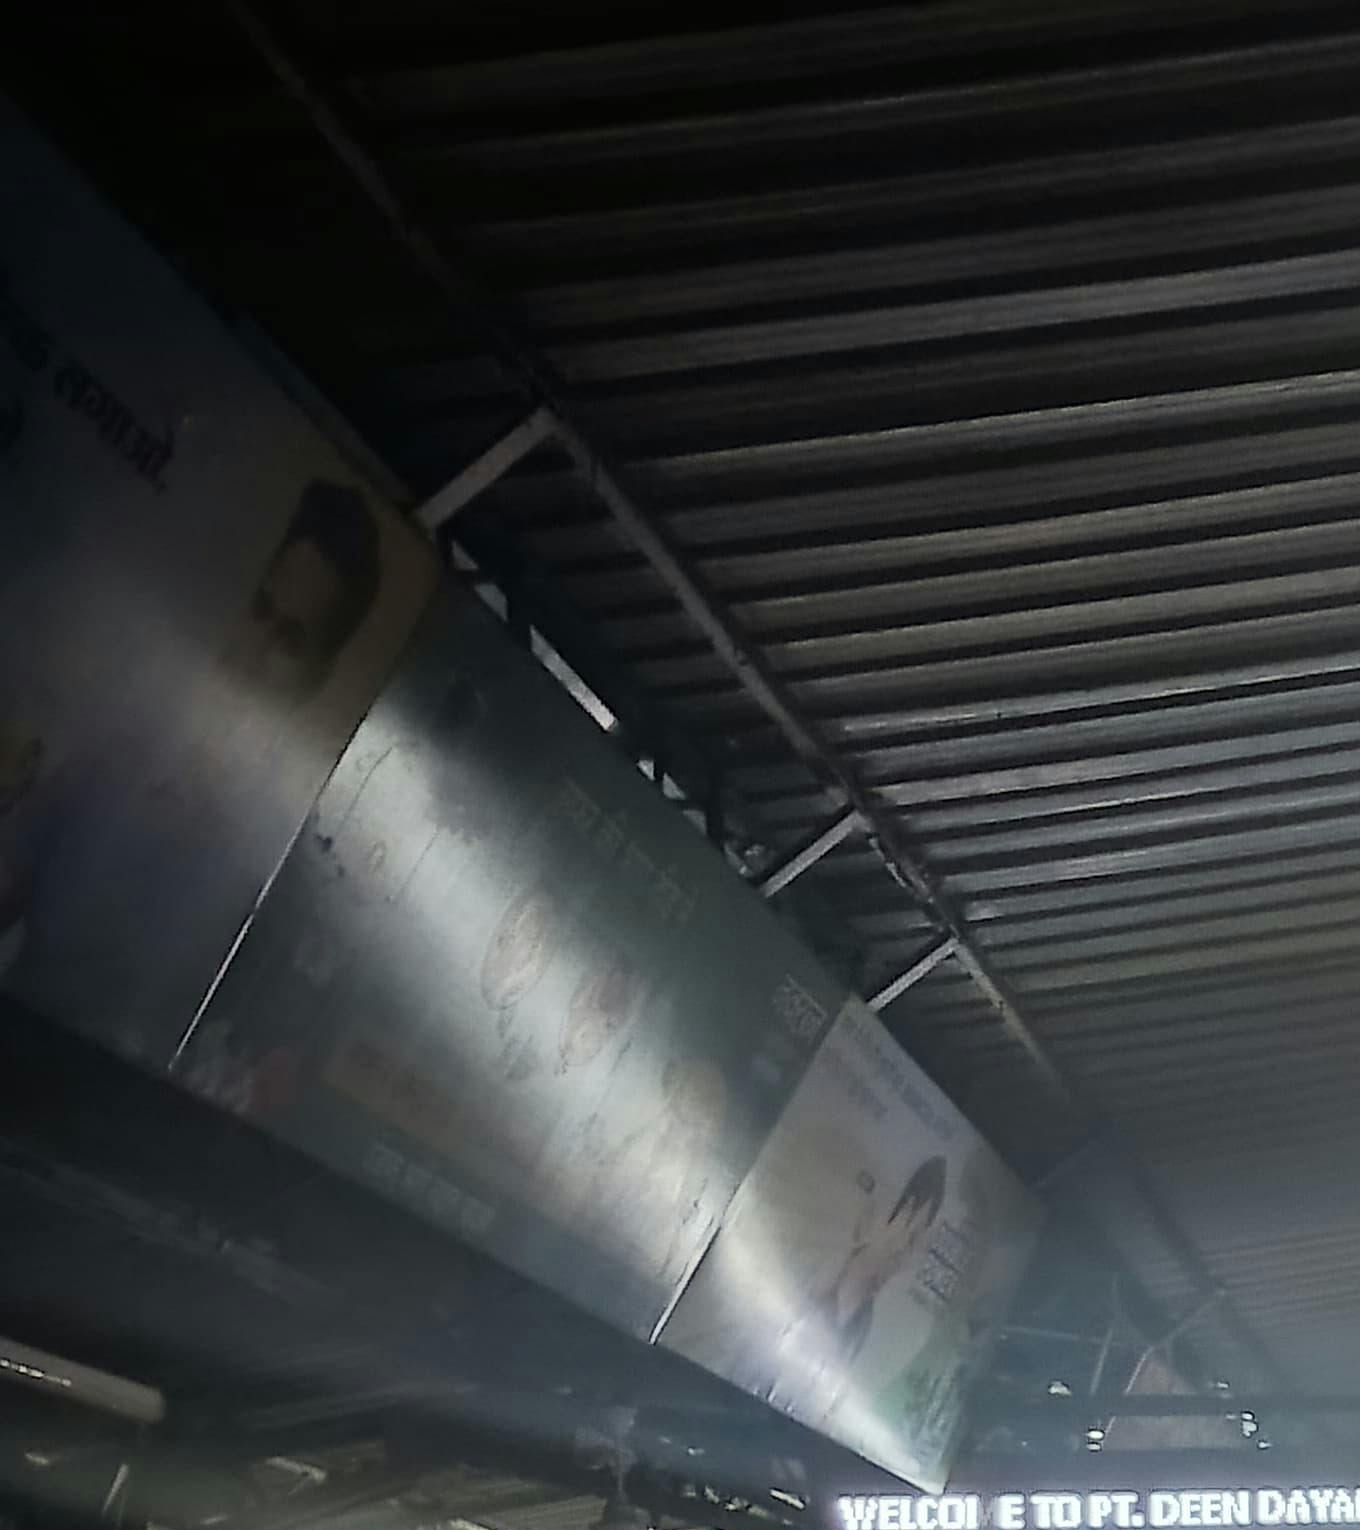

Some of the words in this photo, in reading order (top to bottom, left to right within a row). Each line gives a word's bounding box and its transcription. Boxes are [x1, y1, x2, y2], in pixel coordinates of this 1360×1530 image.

[1030, 1492, 1082, 1530] TO
[1088, 1491, 1146, 1529] PT.
[1149, 1489, 1252, 1528] DEEN
